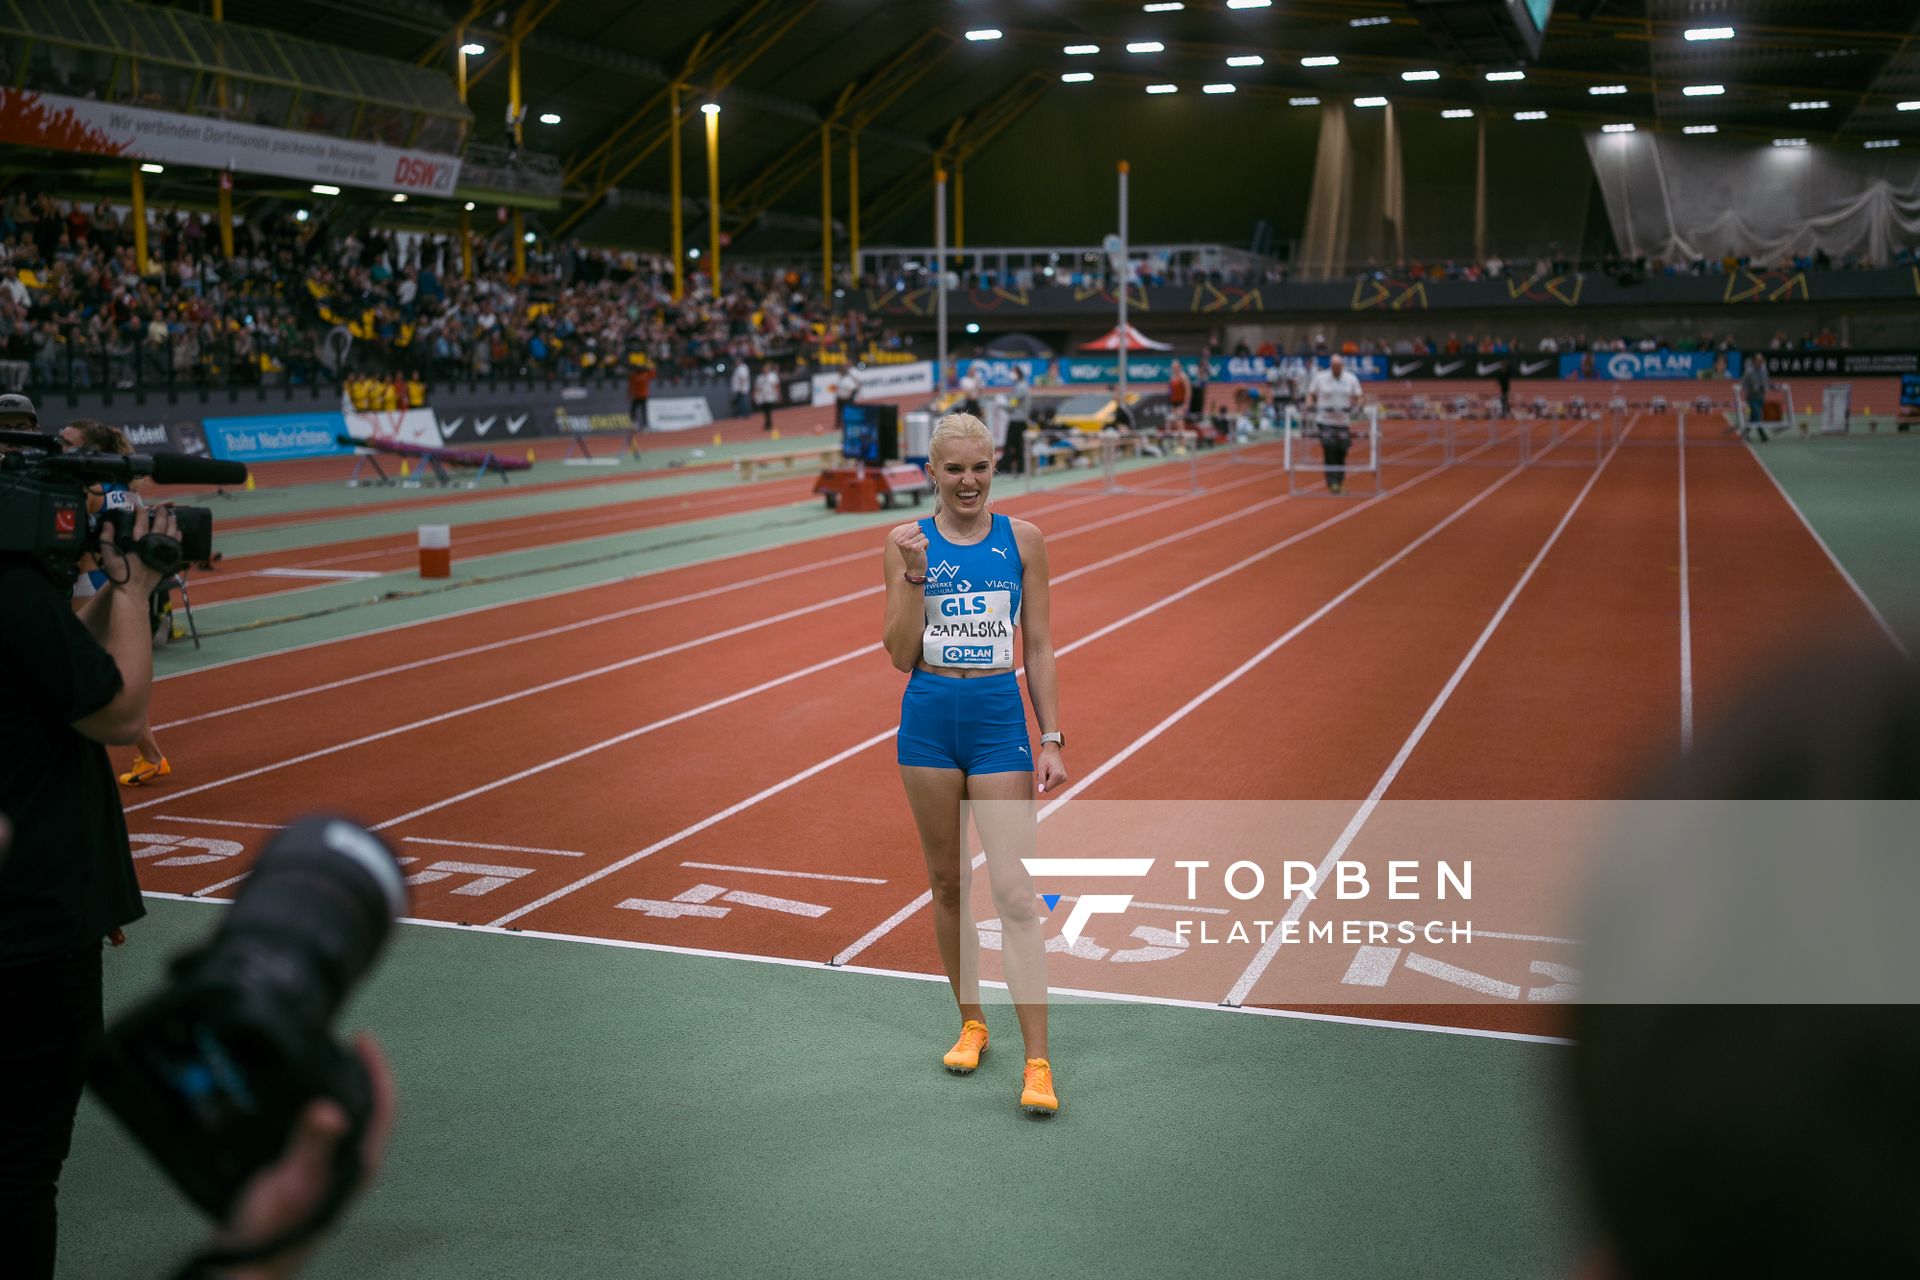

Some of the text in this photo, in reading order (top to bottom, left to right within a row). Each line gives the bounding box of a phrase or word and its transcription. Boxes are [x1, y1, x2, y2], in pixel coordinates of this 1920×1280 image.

[109, 111, 132, 130] Wir
[135, 117, 201, 140] verbinden
[203, 124, 271, 149] Dortmunds
[1643, 355, 1692, 369] PLAN
[1768, 357, 1838, 372] OVAFON
[930, 620, 1008, 638] ZAPALSKA
[964, 648, 992, 658] PLAN
